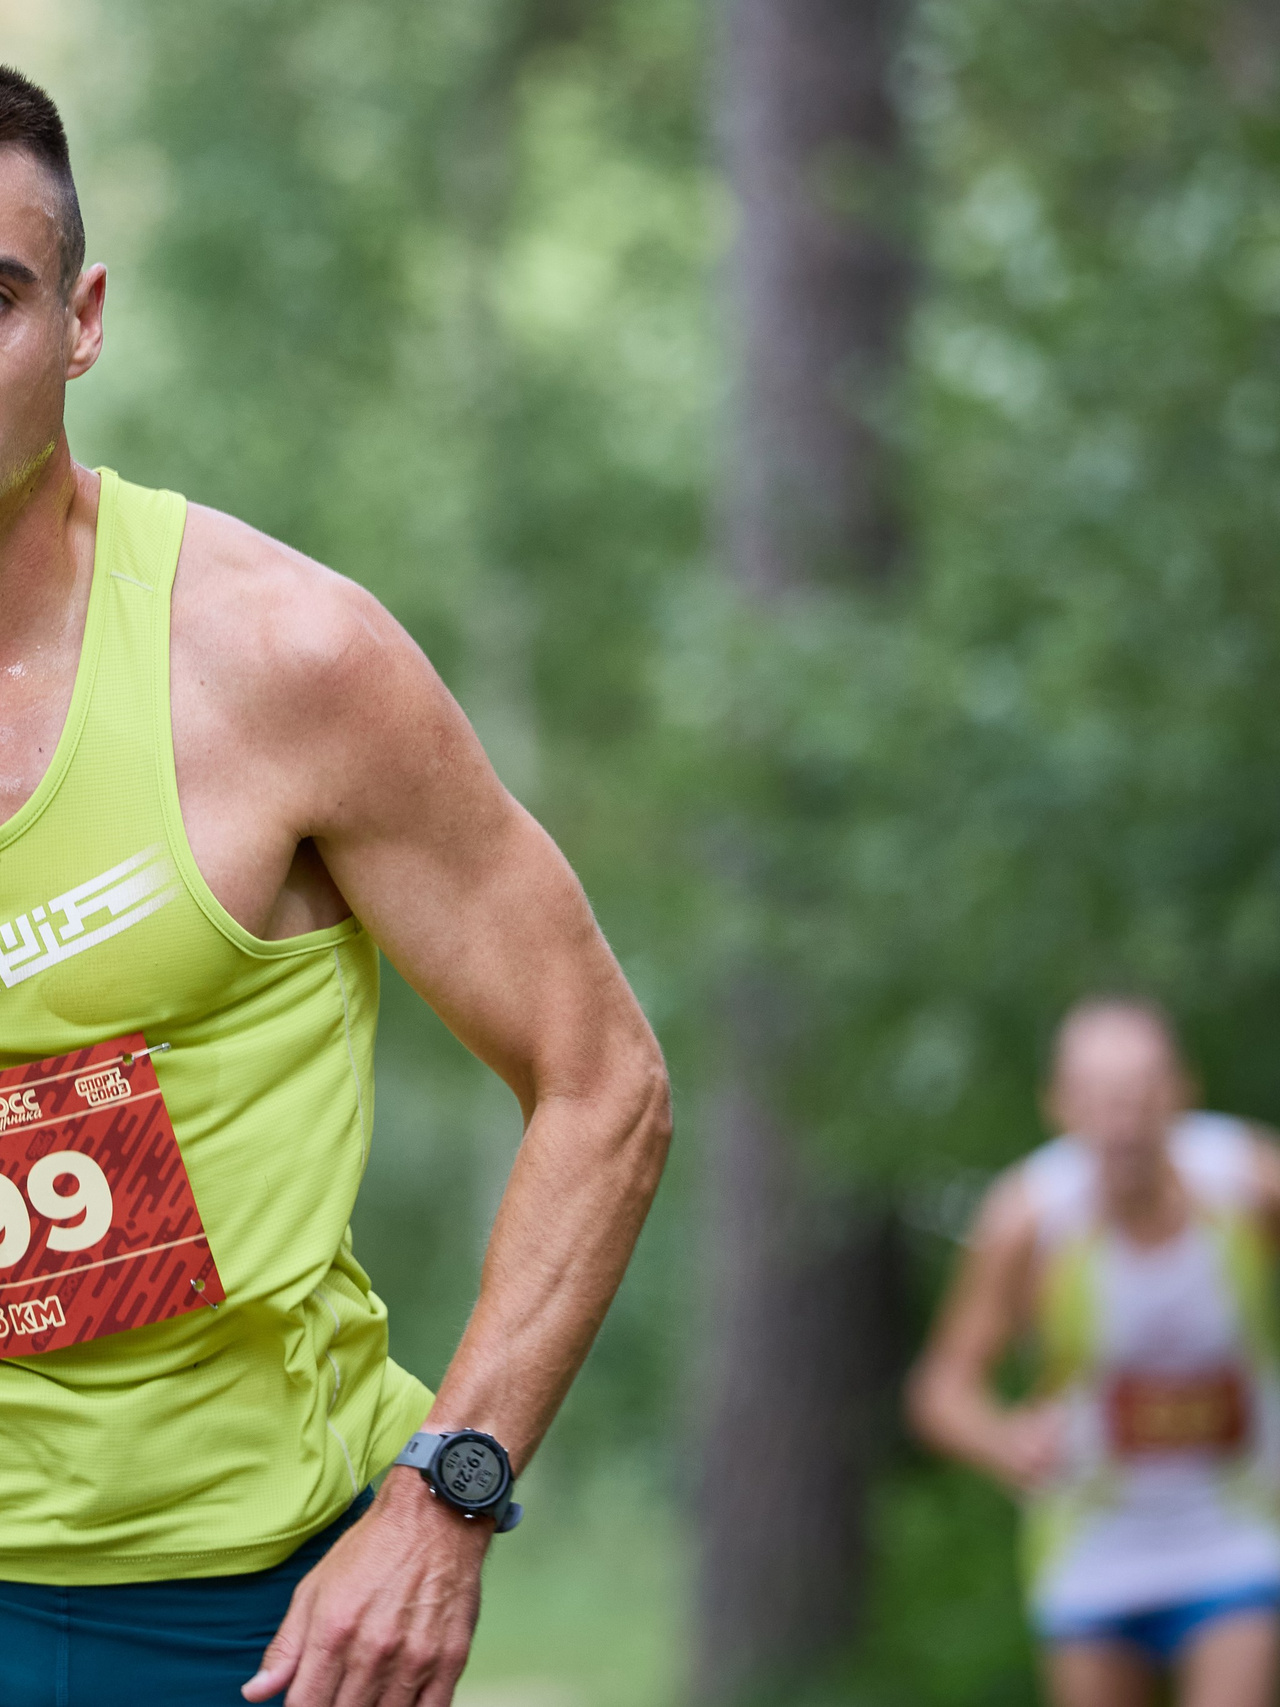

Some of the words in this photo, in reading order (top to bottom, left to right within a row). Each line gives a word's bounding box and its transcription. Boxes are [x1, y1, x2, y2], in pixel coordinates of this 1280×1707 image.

[78, 1071, 118, 1093] СПОРТ
[89, 1082, 128, 1103] СОЮЗ
[8, 1295, 66, 1335] КМ
[452, 1447, 485, 1493] 19:28
